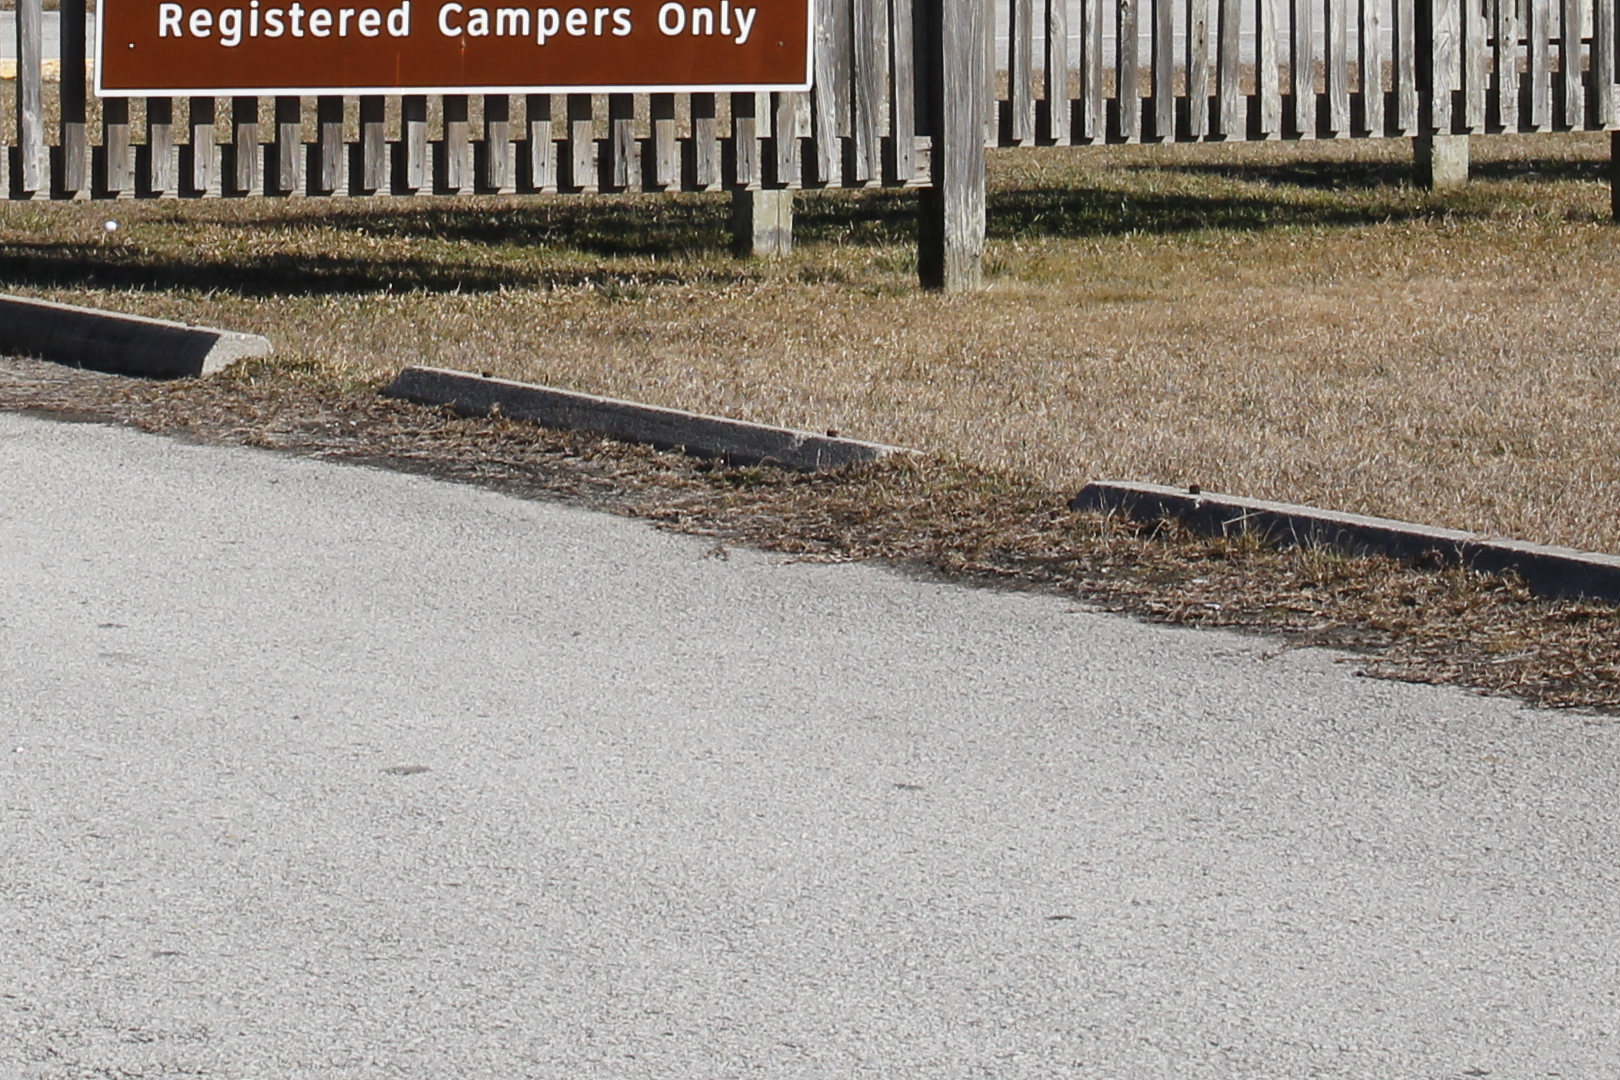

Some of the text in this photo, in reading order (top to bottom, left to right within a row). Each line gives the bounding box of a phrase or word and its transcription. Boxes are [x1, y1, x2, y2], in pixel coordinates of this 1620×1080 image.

[159, 0, 757, 46] Registered Campers Only
